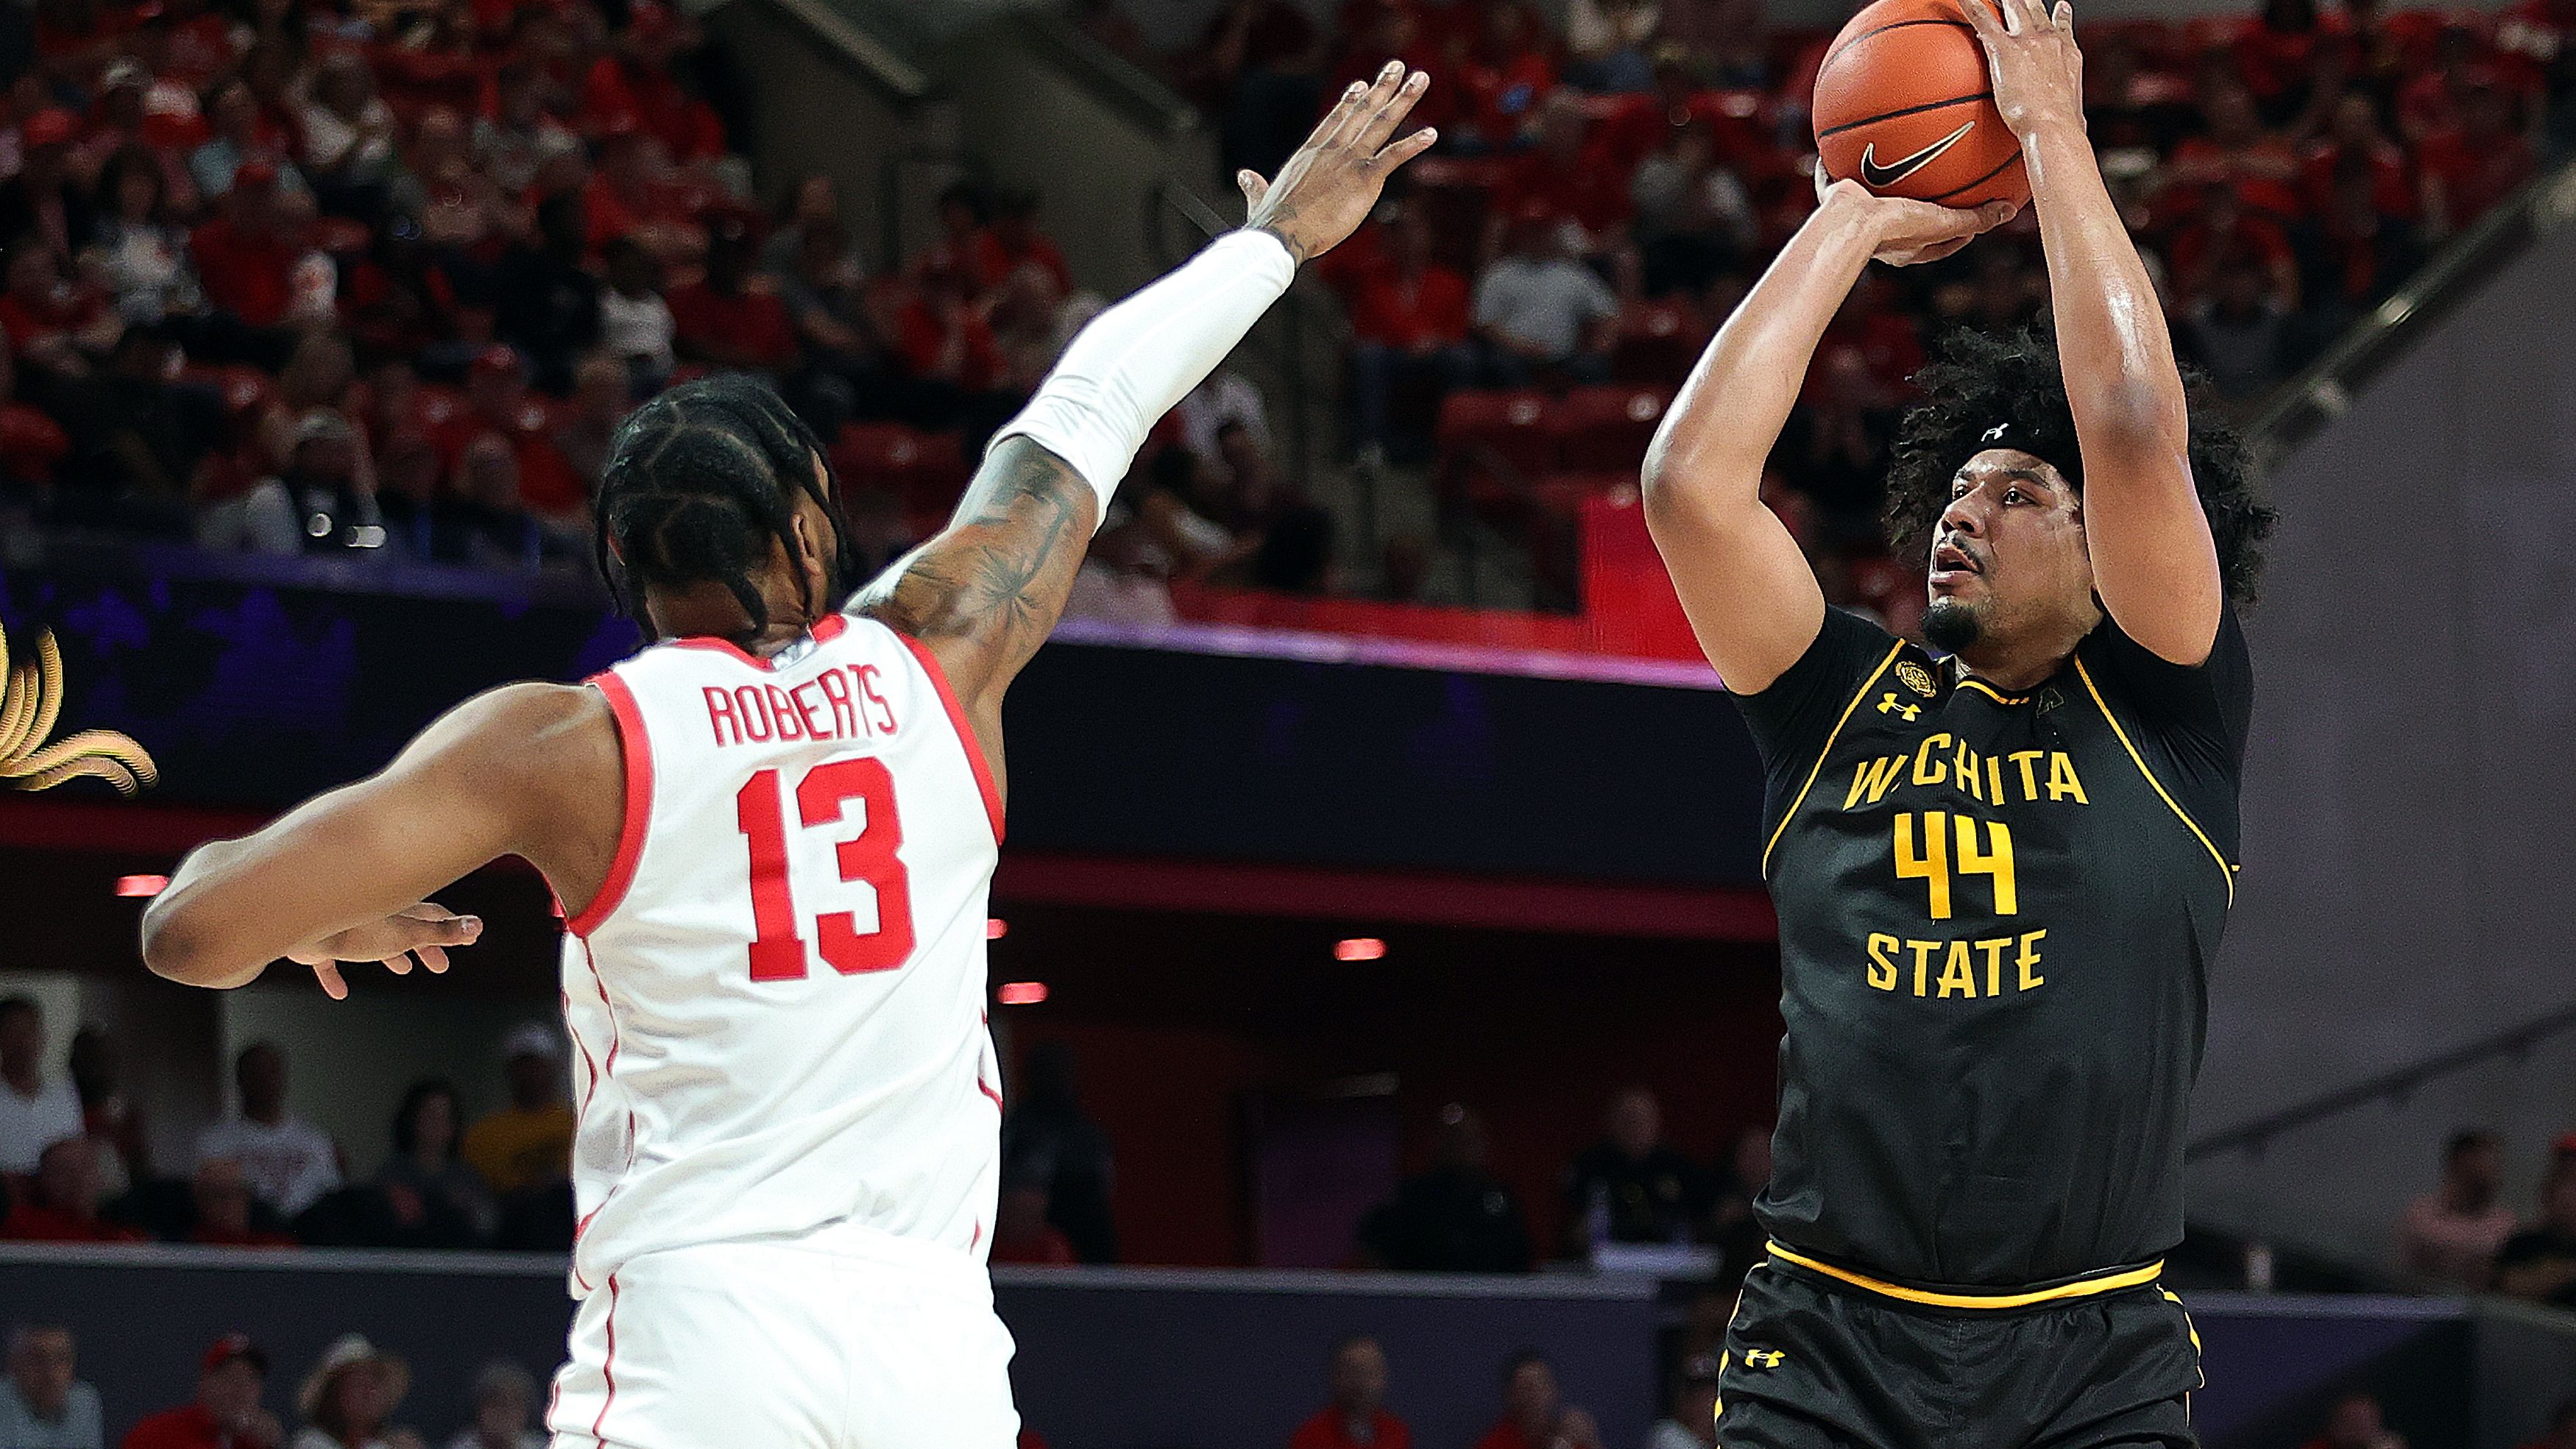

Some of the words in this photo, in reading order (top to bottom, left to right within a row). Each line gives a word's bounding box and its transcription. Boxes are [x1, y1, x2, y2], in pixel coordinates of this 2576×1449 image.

[1842, 733, 2089, 811] WCHITA
[737, 757, 917, 981] 13
[1894, 811, 2018, 919] 44
[1867, 929, 2048, 999] STATE
